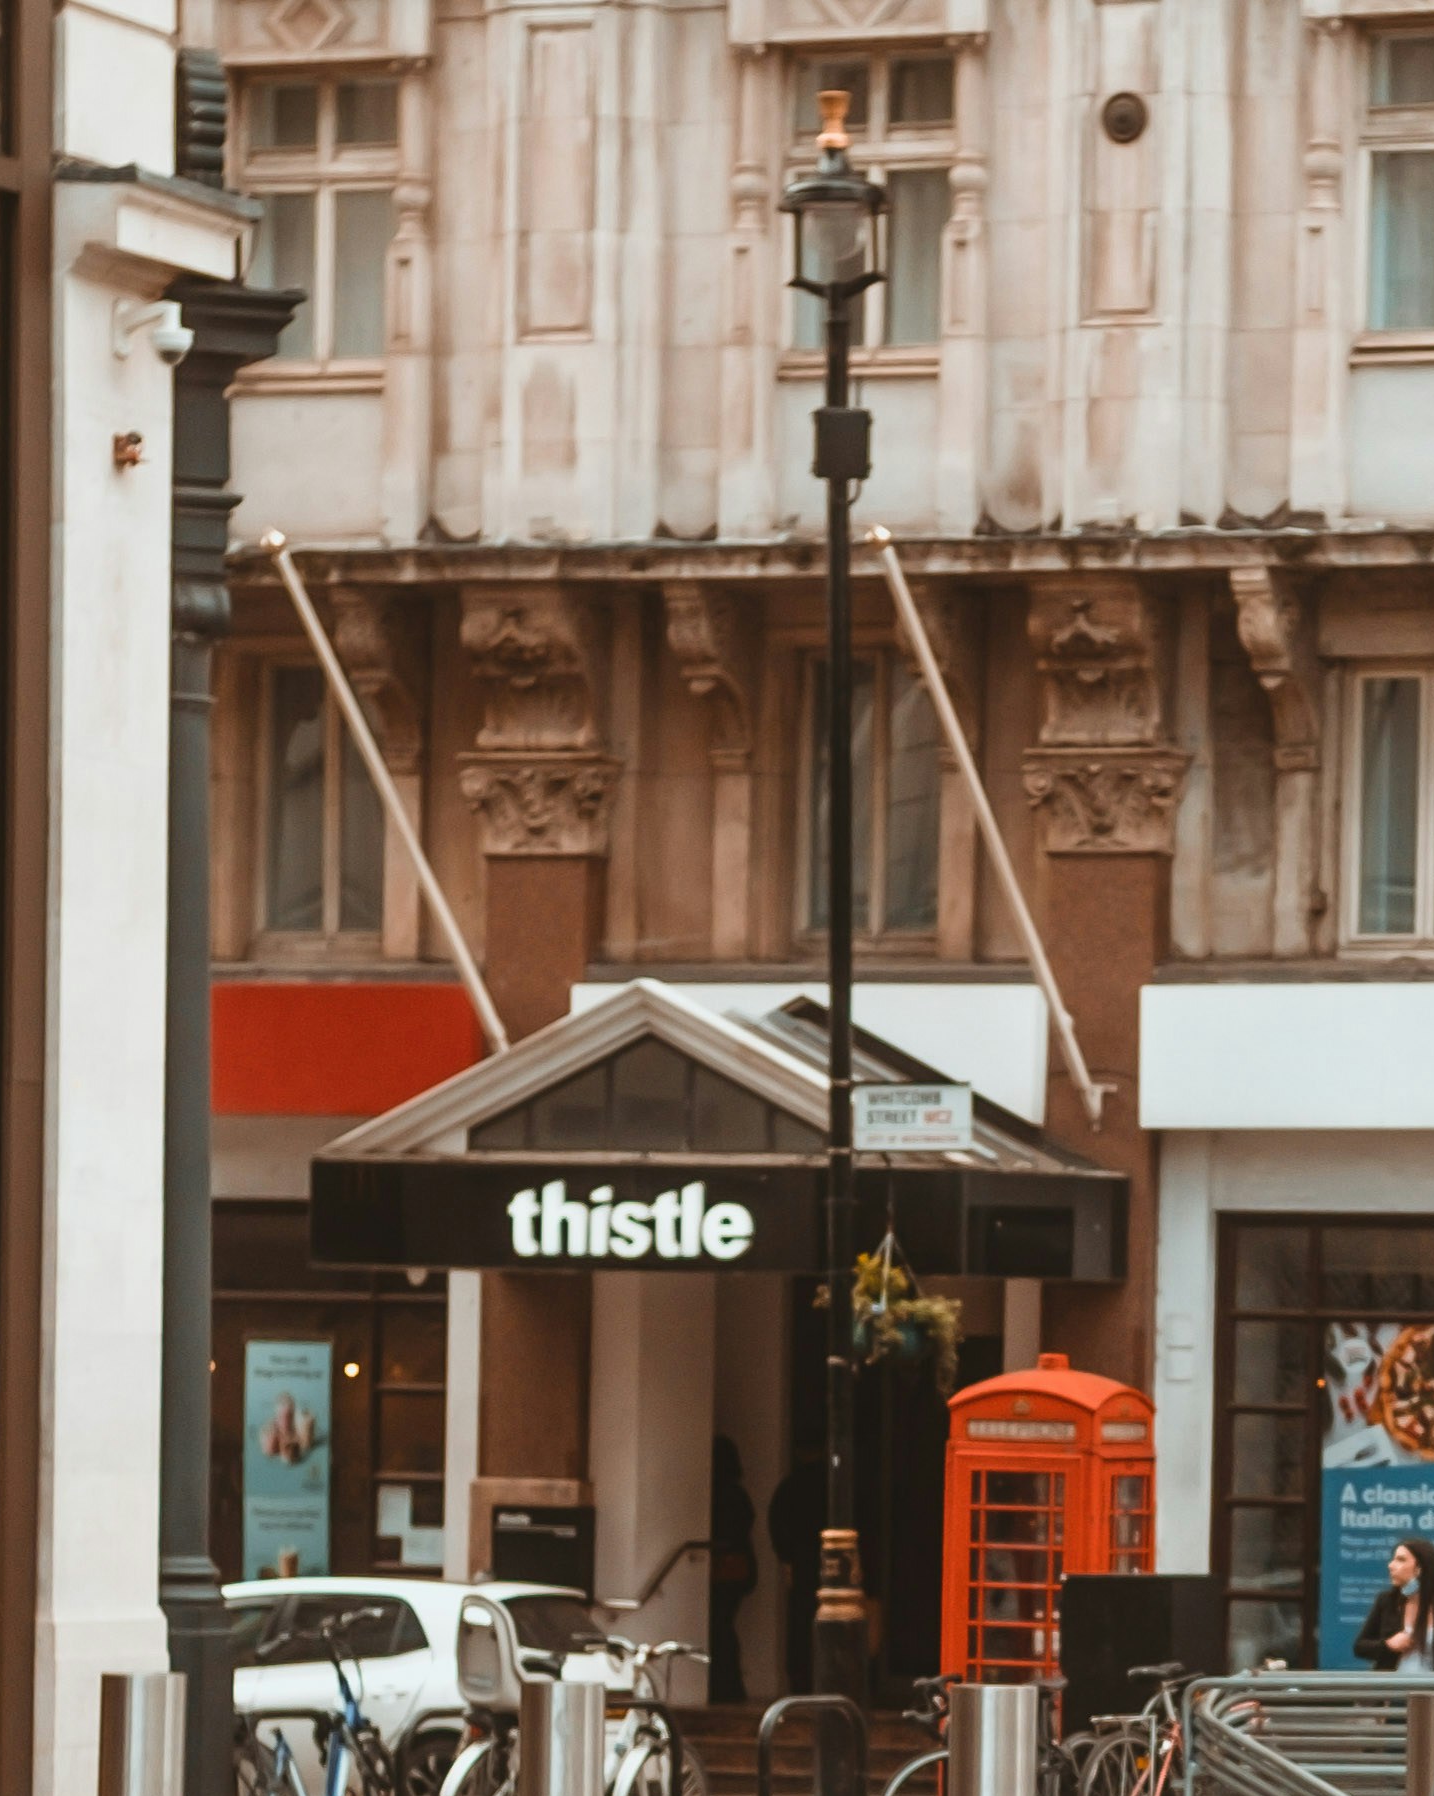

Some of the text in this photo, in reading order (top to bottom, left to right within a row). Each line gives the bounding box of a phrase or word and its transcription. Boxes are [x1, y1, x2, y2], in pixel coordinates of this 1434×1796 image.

[507, 1178, 755, 1261] thistle
[1340, 1482, 1358, 1504] A
[1340, 1507, 1412, 1530] Italian
